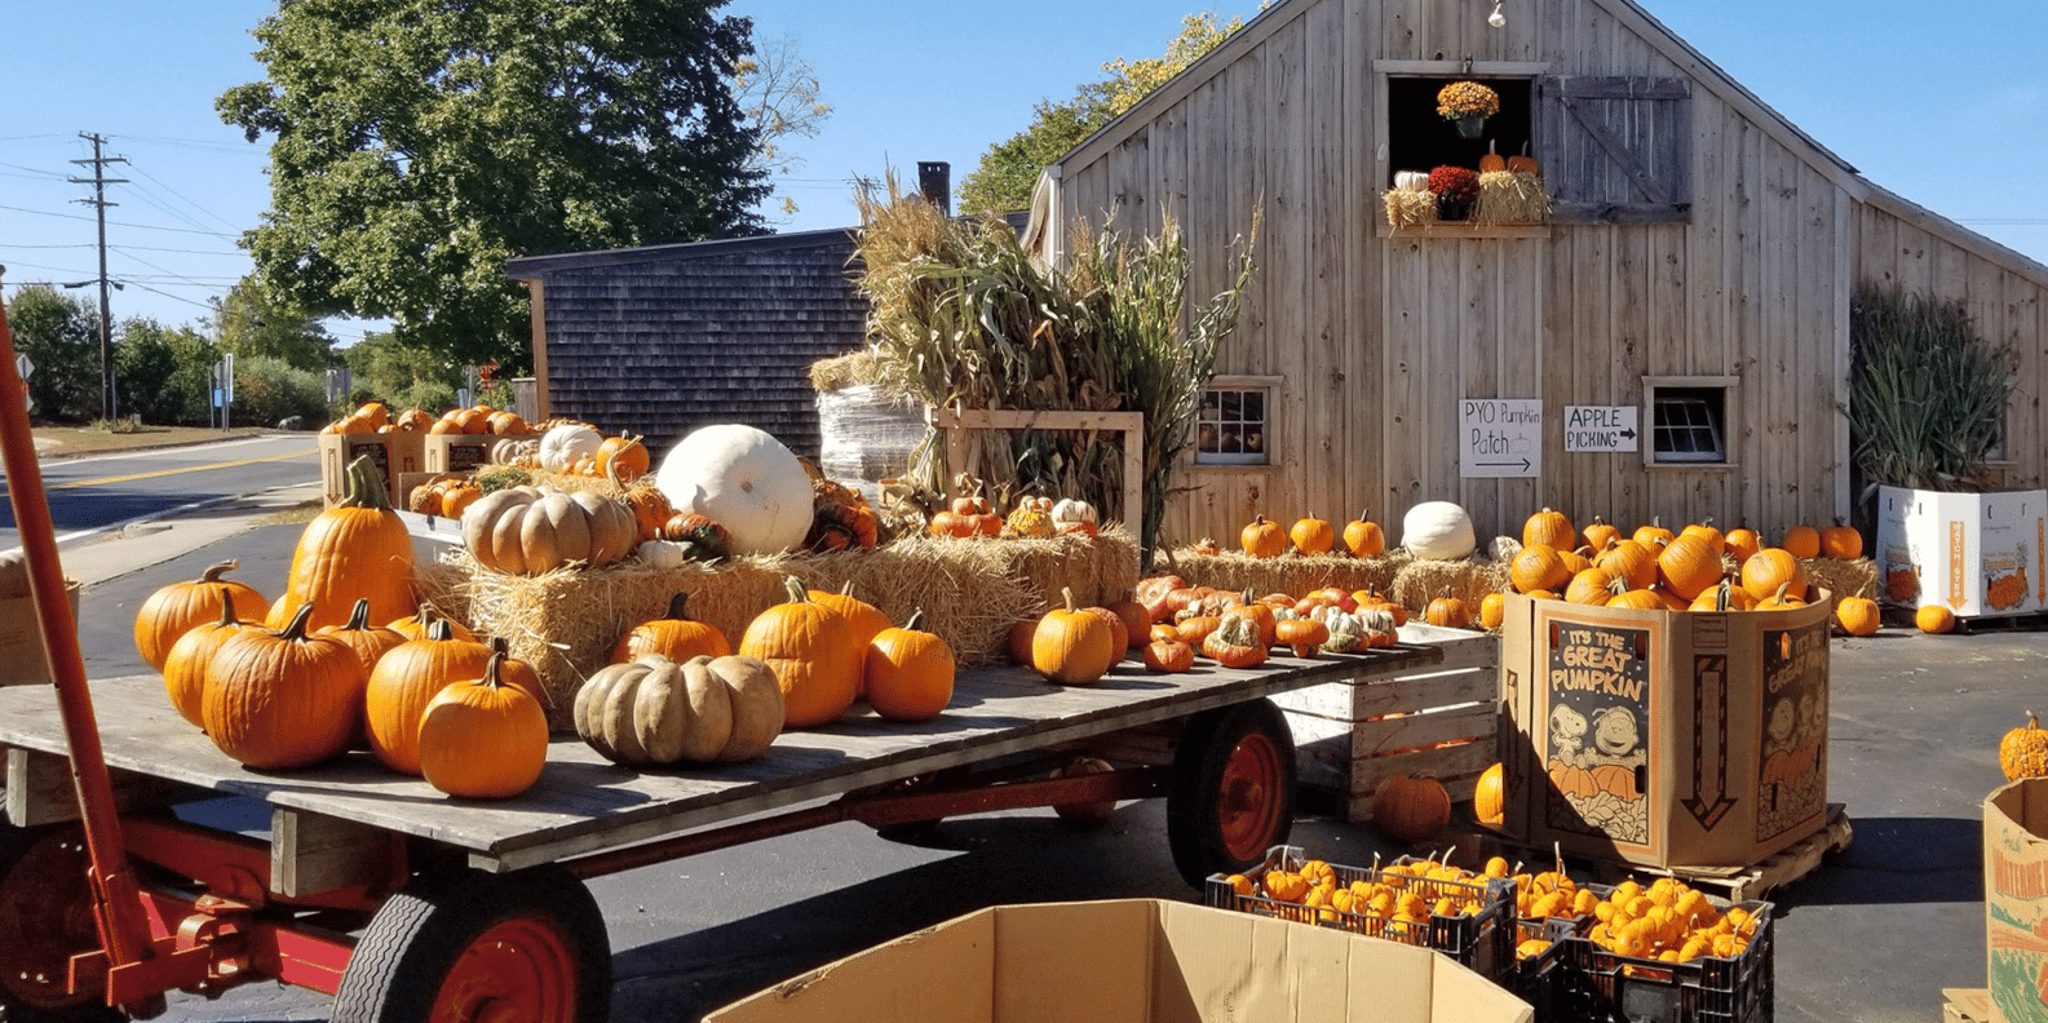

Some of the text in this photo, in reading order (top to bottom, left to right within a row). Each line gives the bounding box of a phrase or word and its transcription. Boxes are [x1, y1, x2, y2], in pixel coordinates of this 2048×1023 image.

[1465, 401, 1540, 426] PYO Pumpkin
[1568, 408, 1621, 428] APPLE
[1472, 428, 1509, 455] Patch
[1567, 431, 1618, 448] PICKING
[1595, 631, 1625, 651] THE
[1563, 645, 1633, 673] GREAT
[1551, 668, 1644, 702] PUMPKIN
